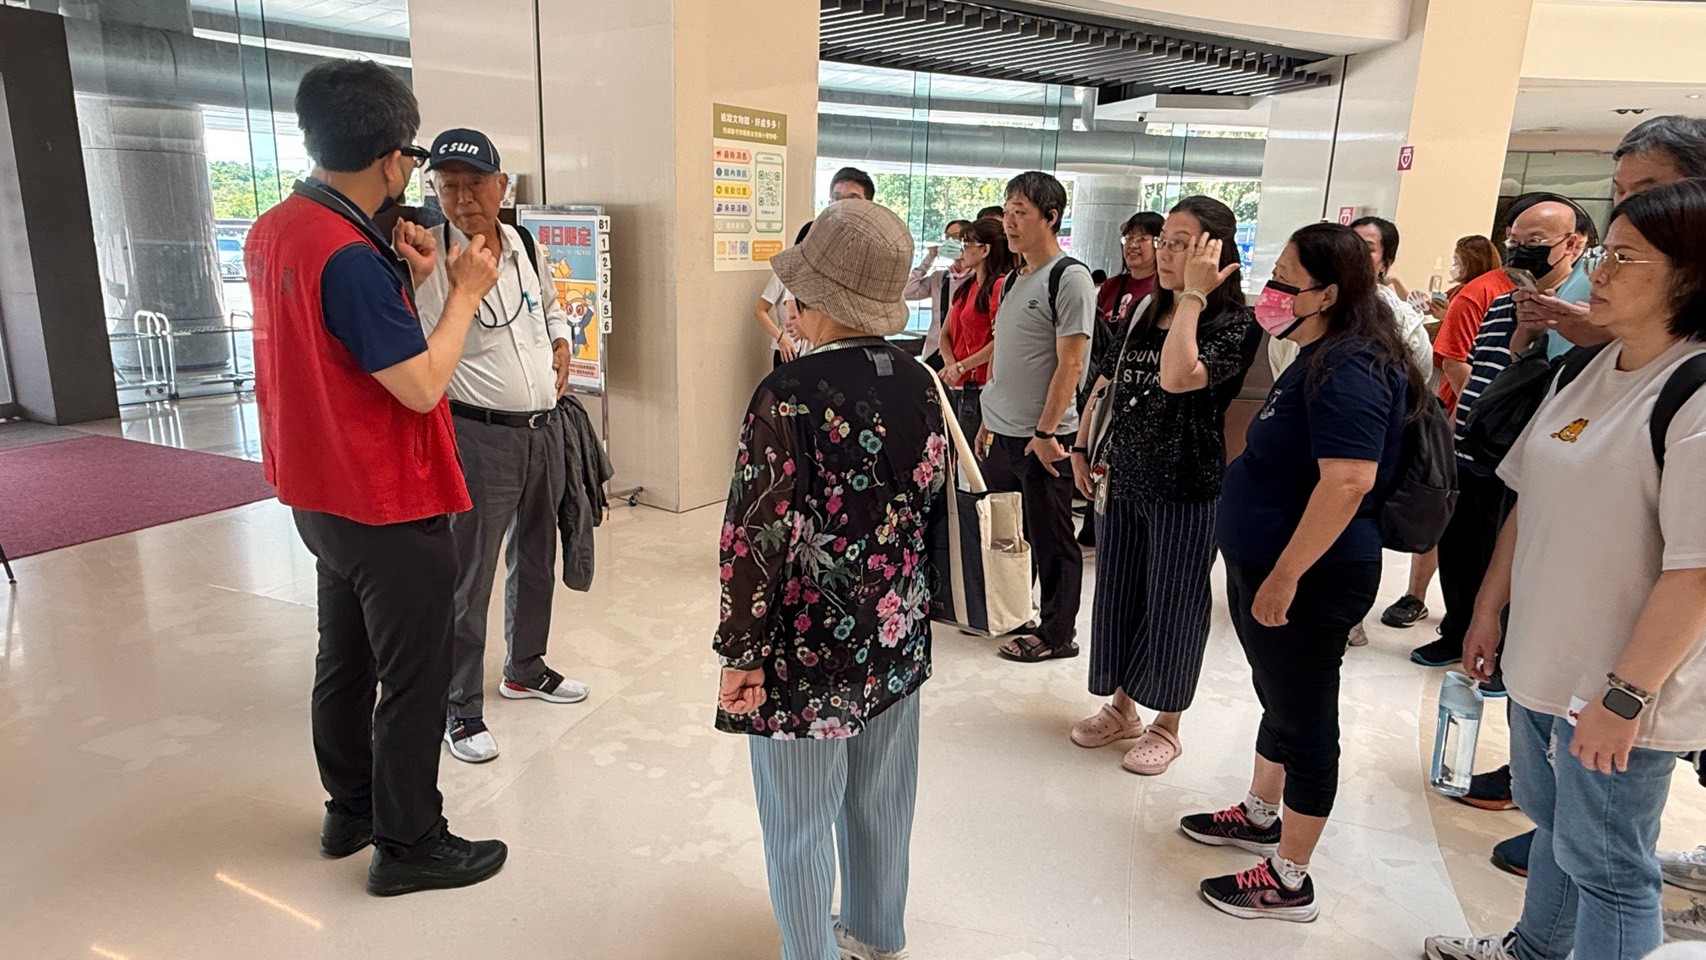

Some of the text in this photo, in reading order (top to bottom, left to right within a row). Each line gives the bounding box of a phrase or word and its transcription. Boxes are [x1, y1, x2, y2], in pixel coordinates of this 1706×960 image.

[724, 150, 747, 160] 最新消息
[598, 219, 609, 230] B1
[538, 225, 591, 247] 假日限定
[601, 238, 606, 249] 1
[602, 257, 608, 267] 2
[602, 273, 608, 284] 3
[602, 290, 608, 299] 4
[603, 305, 609, 315] 5
[604, 321, 610, 331] 6
